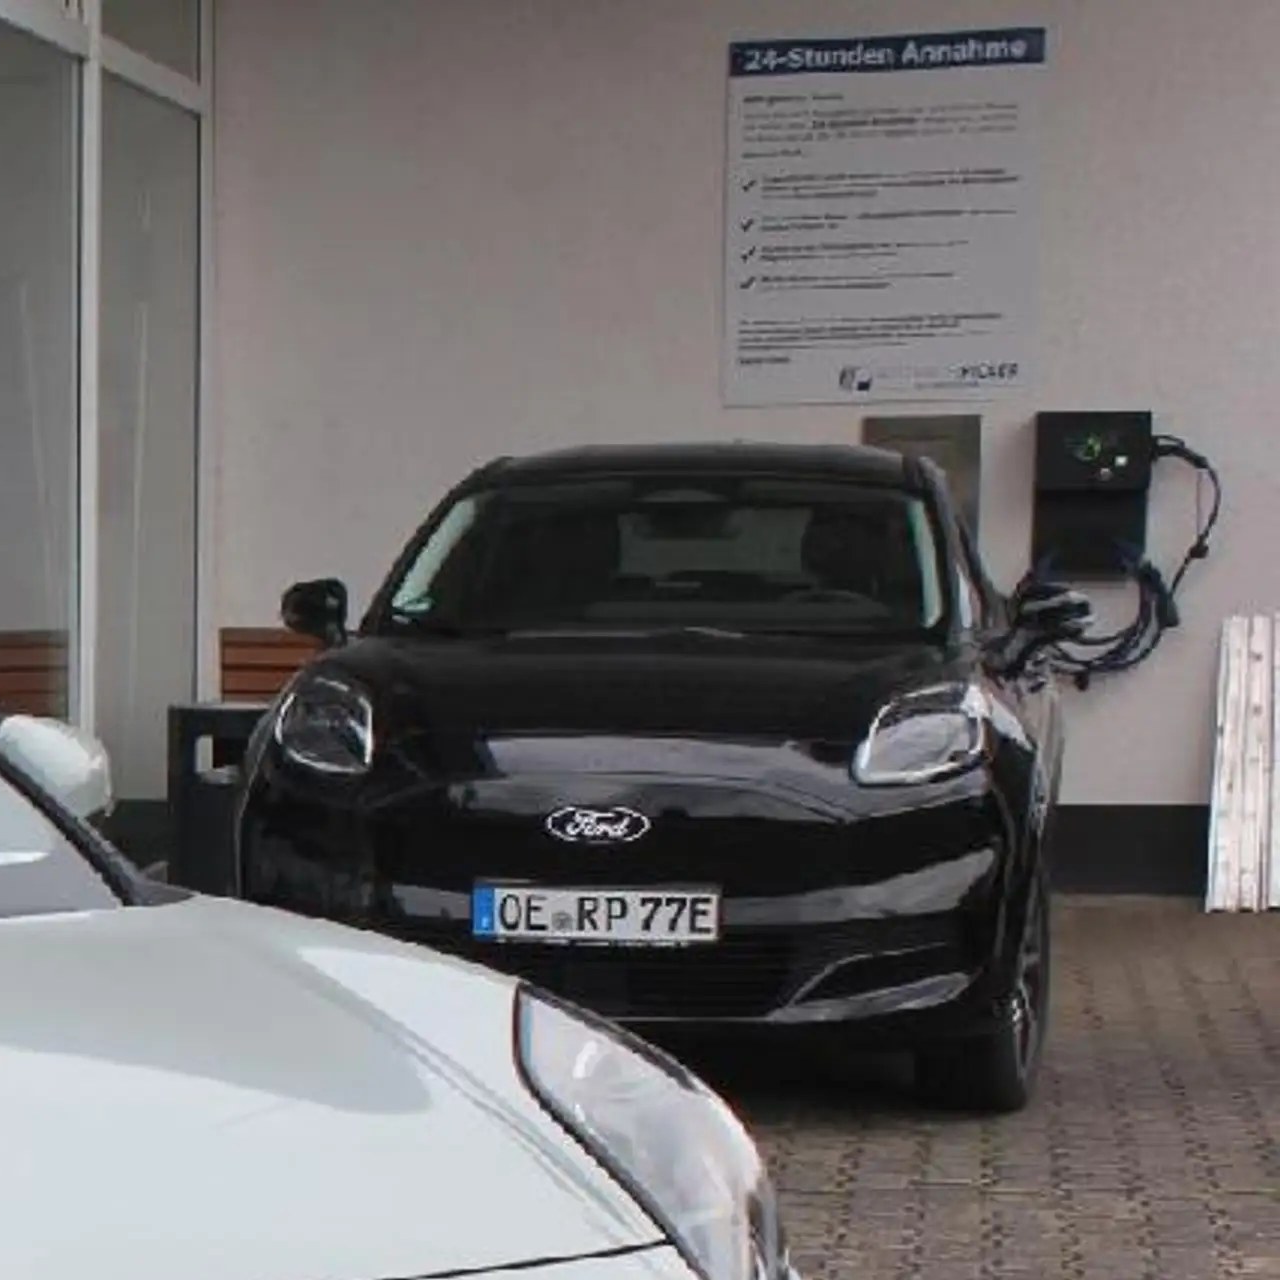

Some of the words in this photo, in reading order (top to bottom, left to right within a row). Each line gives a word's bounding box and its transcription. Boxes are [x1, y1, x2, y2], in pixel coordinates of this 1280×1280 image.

[744, 42, 892, 71] 24-Stunden
[901, 39, 1028, 64] Annahme
[566, 811, 630, 837] Ford
[499, 894, 548, 931] OE
[576, 896, 628, 931] RP
[640, 897, 713, 933] 77E
